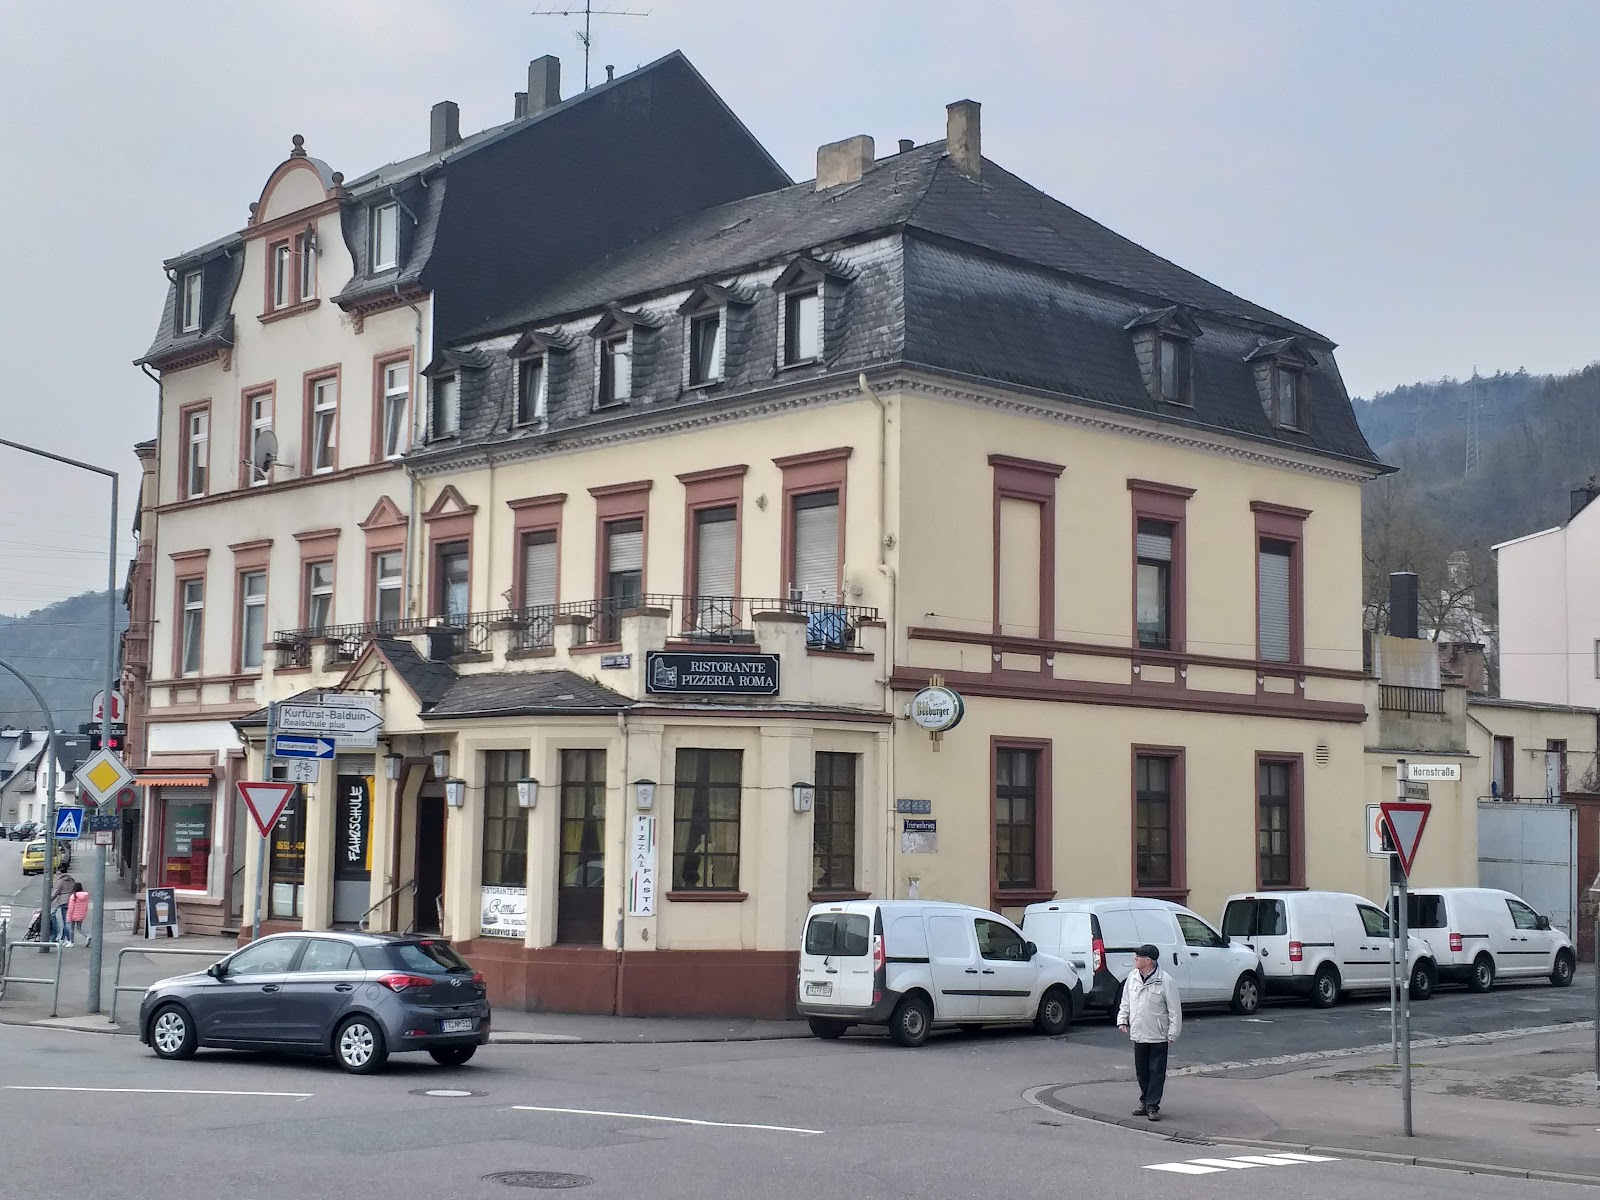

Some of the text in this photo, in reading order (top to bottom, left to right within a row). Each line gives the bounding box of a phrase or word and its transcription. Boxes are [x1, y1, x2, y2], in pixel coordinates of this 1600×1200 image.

[691, 661, 766, 674] RISTORANTE
[681, 674, 774, 688] PIZZERIA ROMA
[283, 707, 372, 721] Kurfürst-Balduin-
[916, 700, 950, 718] Bitburger
[283, 719, 346, 729] Realschule plus
[1413, 766, 1455, 777] Hornstraße
[347, 785, 363, 862] FAHRSCHULE
[637, 816, 647, 860] PIZZA
[642, 868, 652, 912] PASTA
